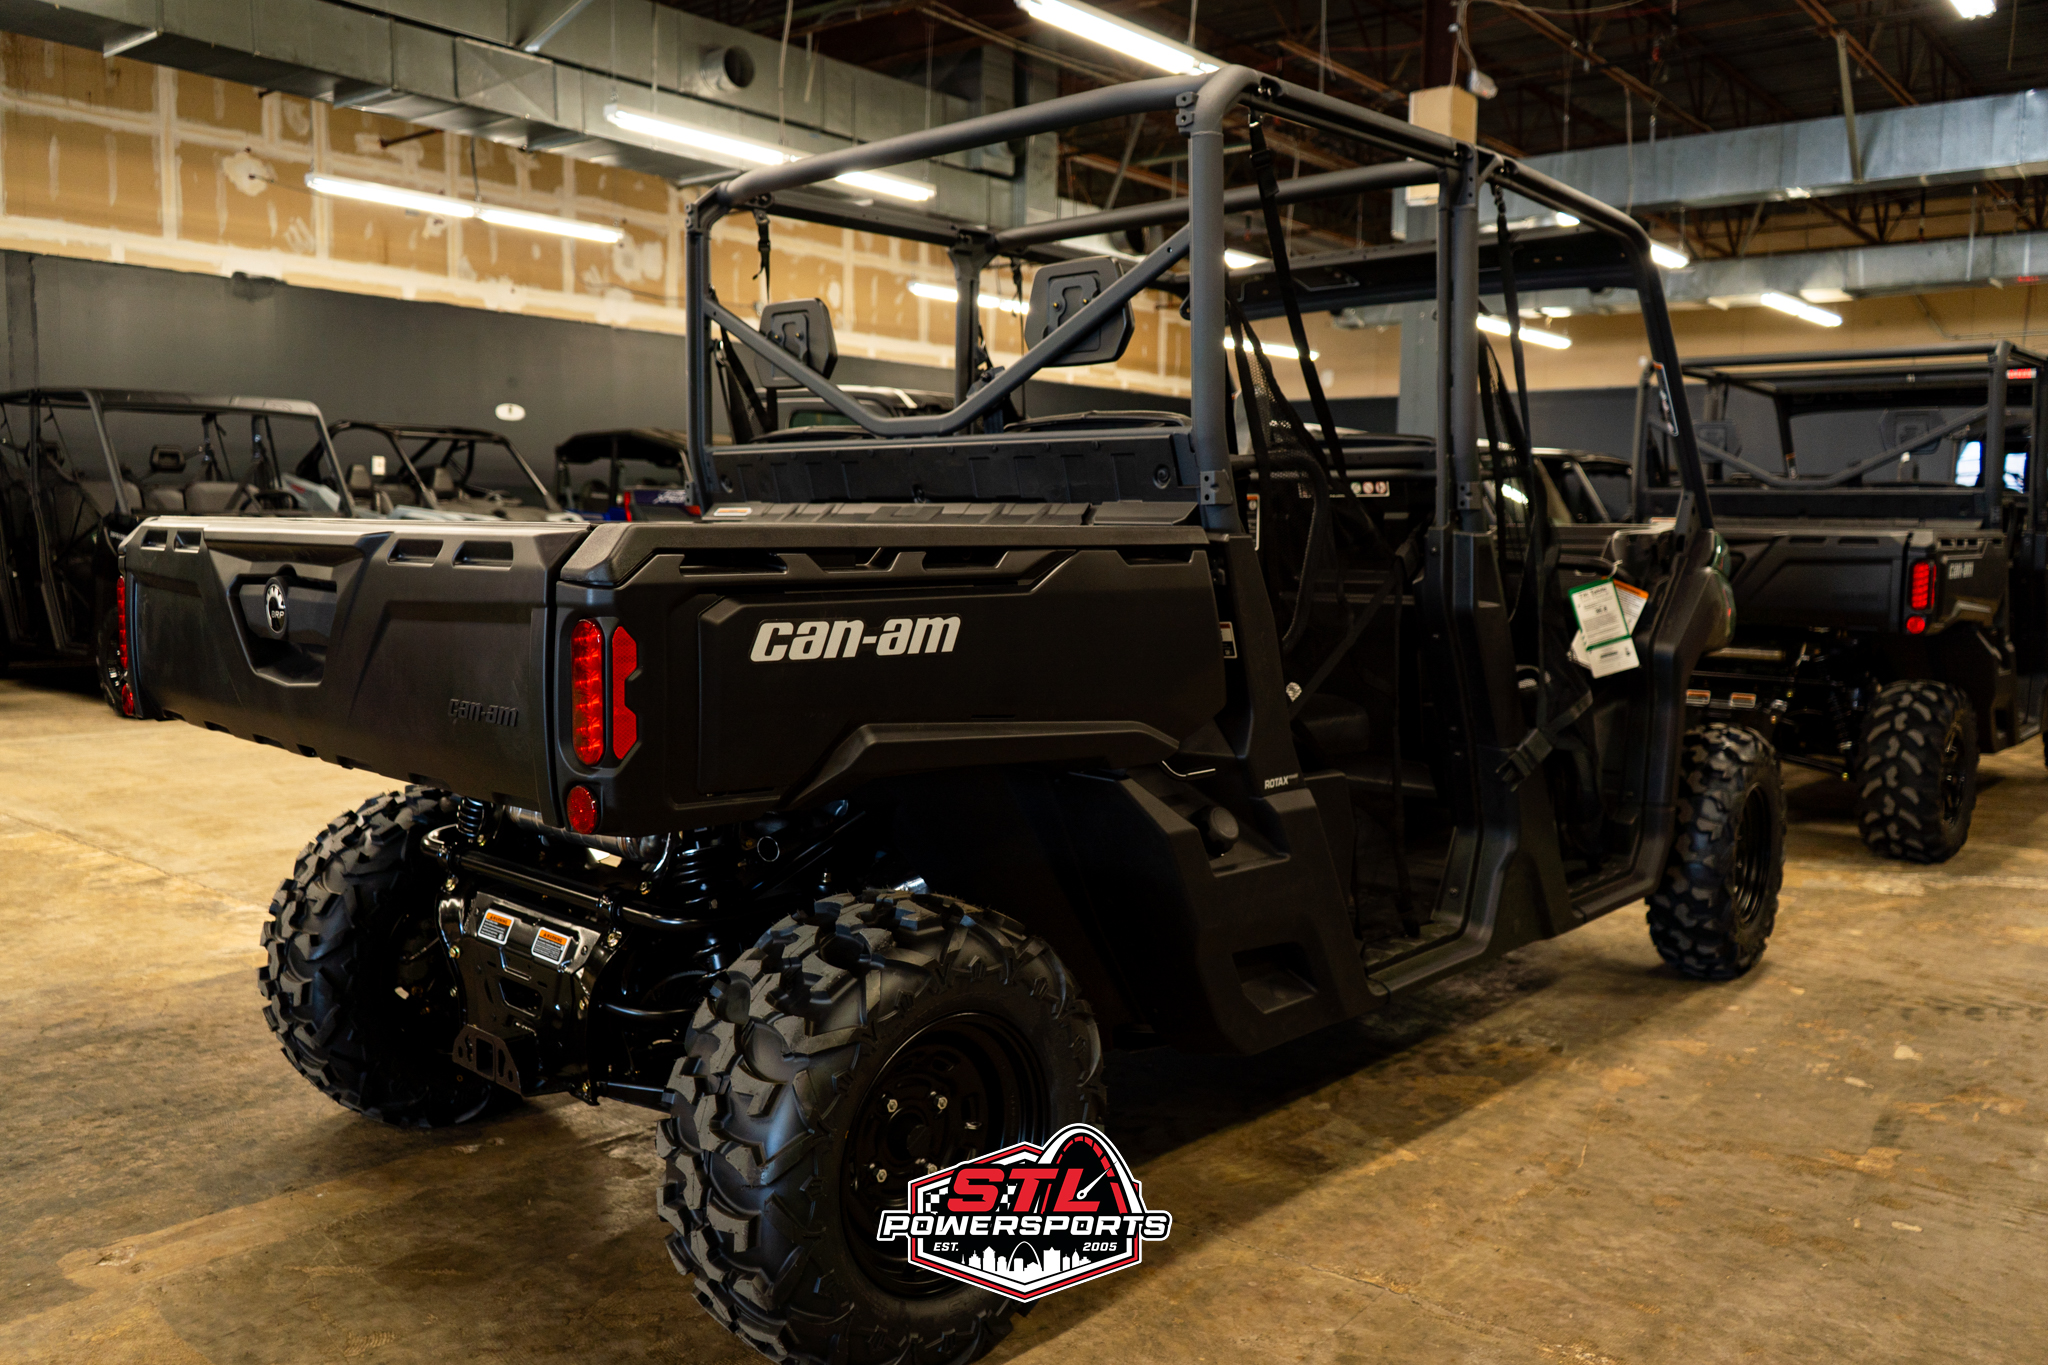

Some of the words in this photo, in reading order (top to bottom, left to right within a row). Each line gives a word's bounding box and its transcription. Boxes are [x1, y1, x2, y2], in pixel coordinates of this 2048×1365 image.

[271, 610, 285, 618] BRP
[750, 616, 961, 662] can-am
[448, 698, 518, 727] can-am
[1264, 775, 1289, 789] ROTAX
